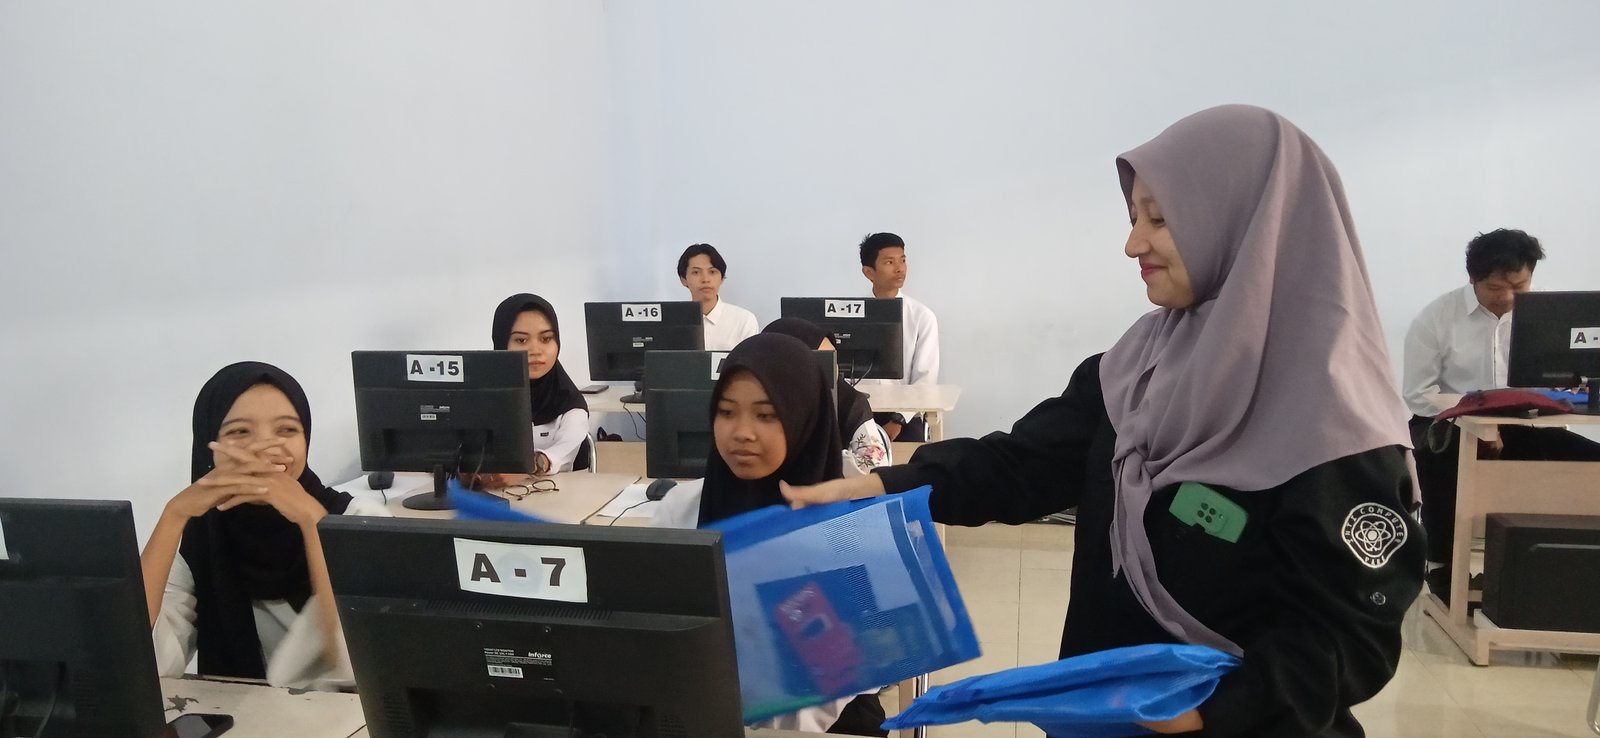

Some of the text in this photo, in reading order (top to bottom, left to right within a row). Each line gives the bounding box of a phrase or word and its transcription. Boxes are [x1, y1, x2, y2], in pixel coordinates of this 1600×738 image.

[625, 307, 659, 317] A -16
[827, 303, 862, 313] A -17
[1574, 332, 1587, 344] A
[410, 359, 460, 376] A -15
[470, 552, 501, 583] A
[540, 557, 566, 587] 7
